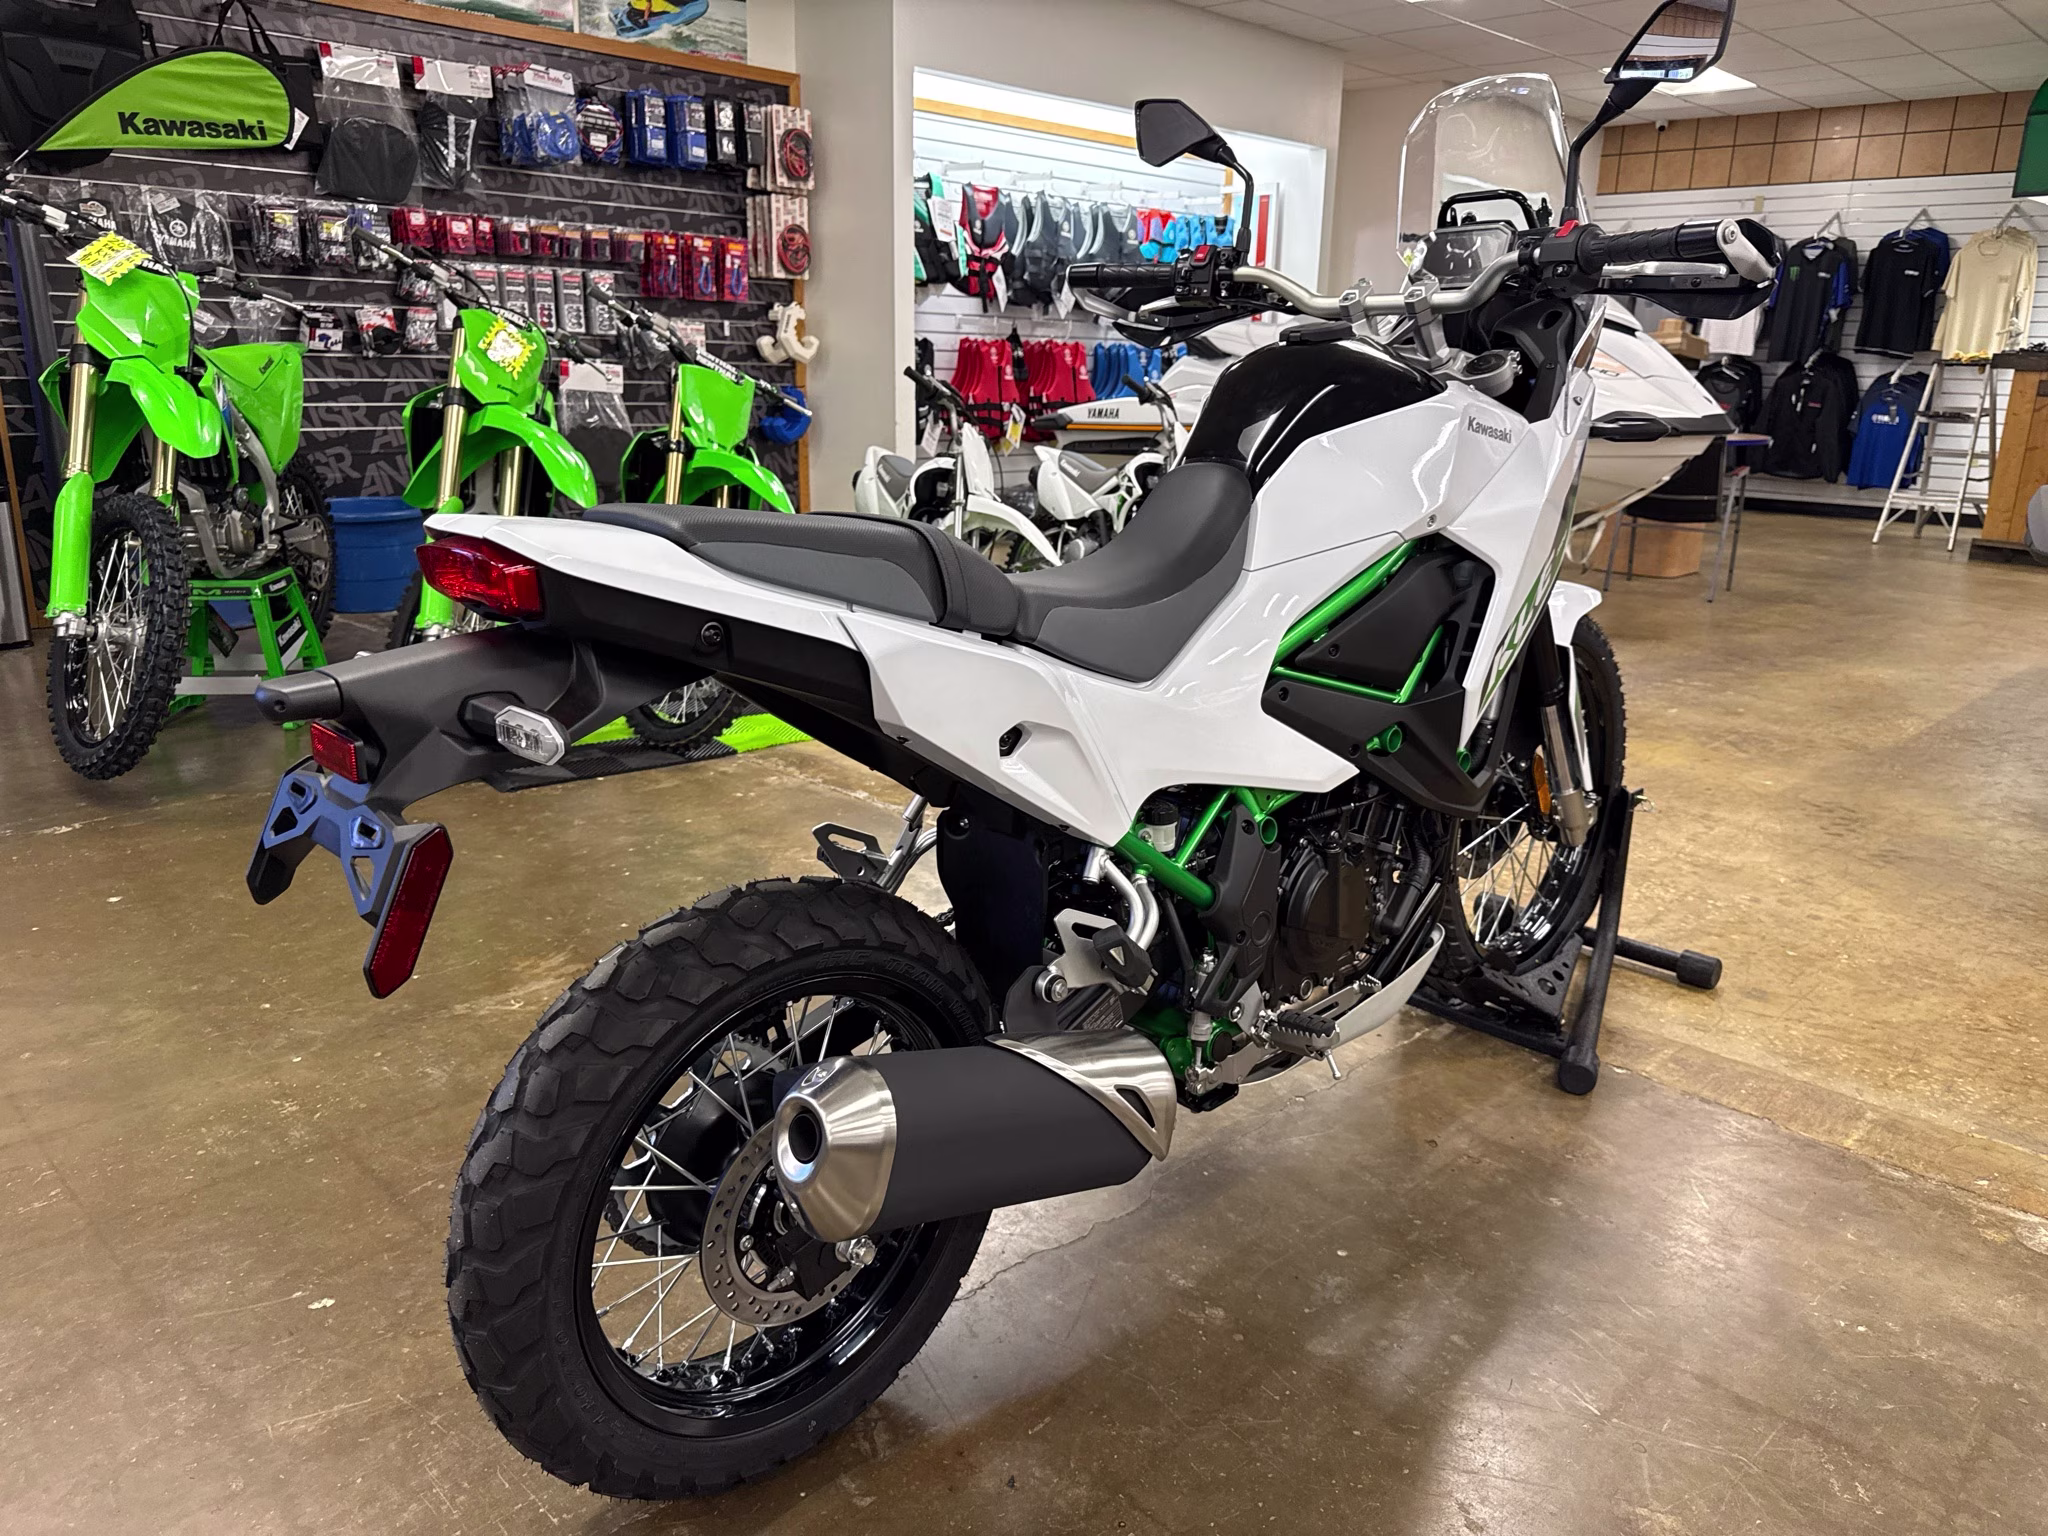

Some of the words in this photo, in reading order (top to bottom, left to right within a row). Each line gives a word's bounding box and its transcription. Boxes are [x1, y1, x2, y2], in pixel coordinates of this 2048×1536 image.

[117, 112, 268, 141] Kawasaki
[1087, 408, 1119, 419] YAMAHA
[1467, 415, 1511, 443] Kawasaki
[884, 957, 944, 999] TRAIL
